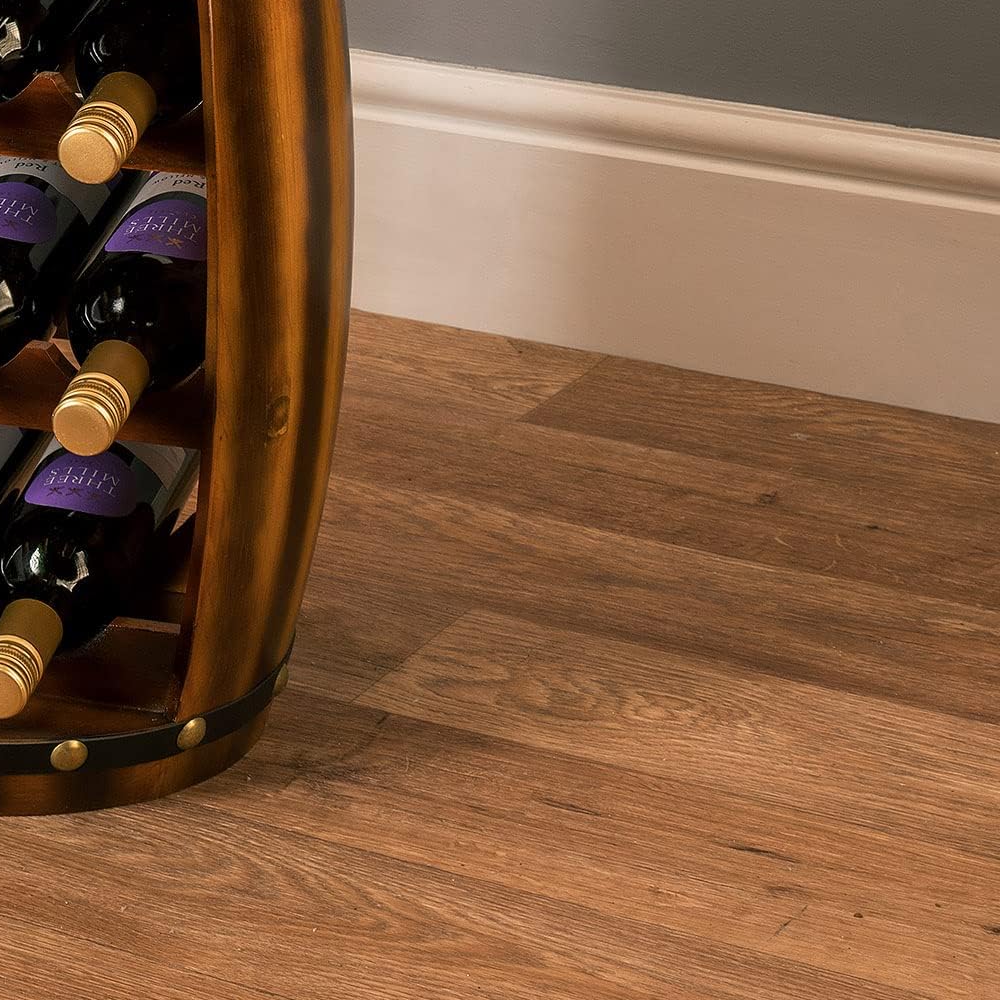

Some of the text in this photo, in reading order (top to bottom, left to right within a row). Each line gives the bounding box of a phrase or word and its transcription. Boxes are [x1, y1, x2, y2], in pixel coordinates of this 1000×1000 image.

[14, 162, 47, 172] Red
[172, 180, 206, 189] Red
[123, 224, 198, 243] THREE
[130, 216, 201, 233] MILLS
[49, 466, 120, 487] MILLS
[43, 475, 116, 498] THREE
